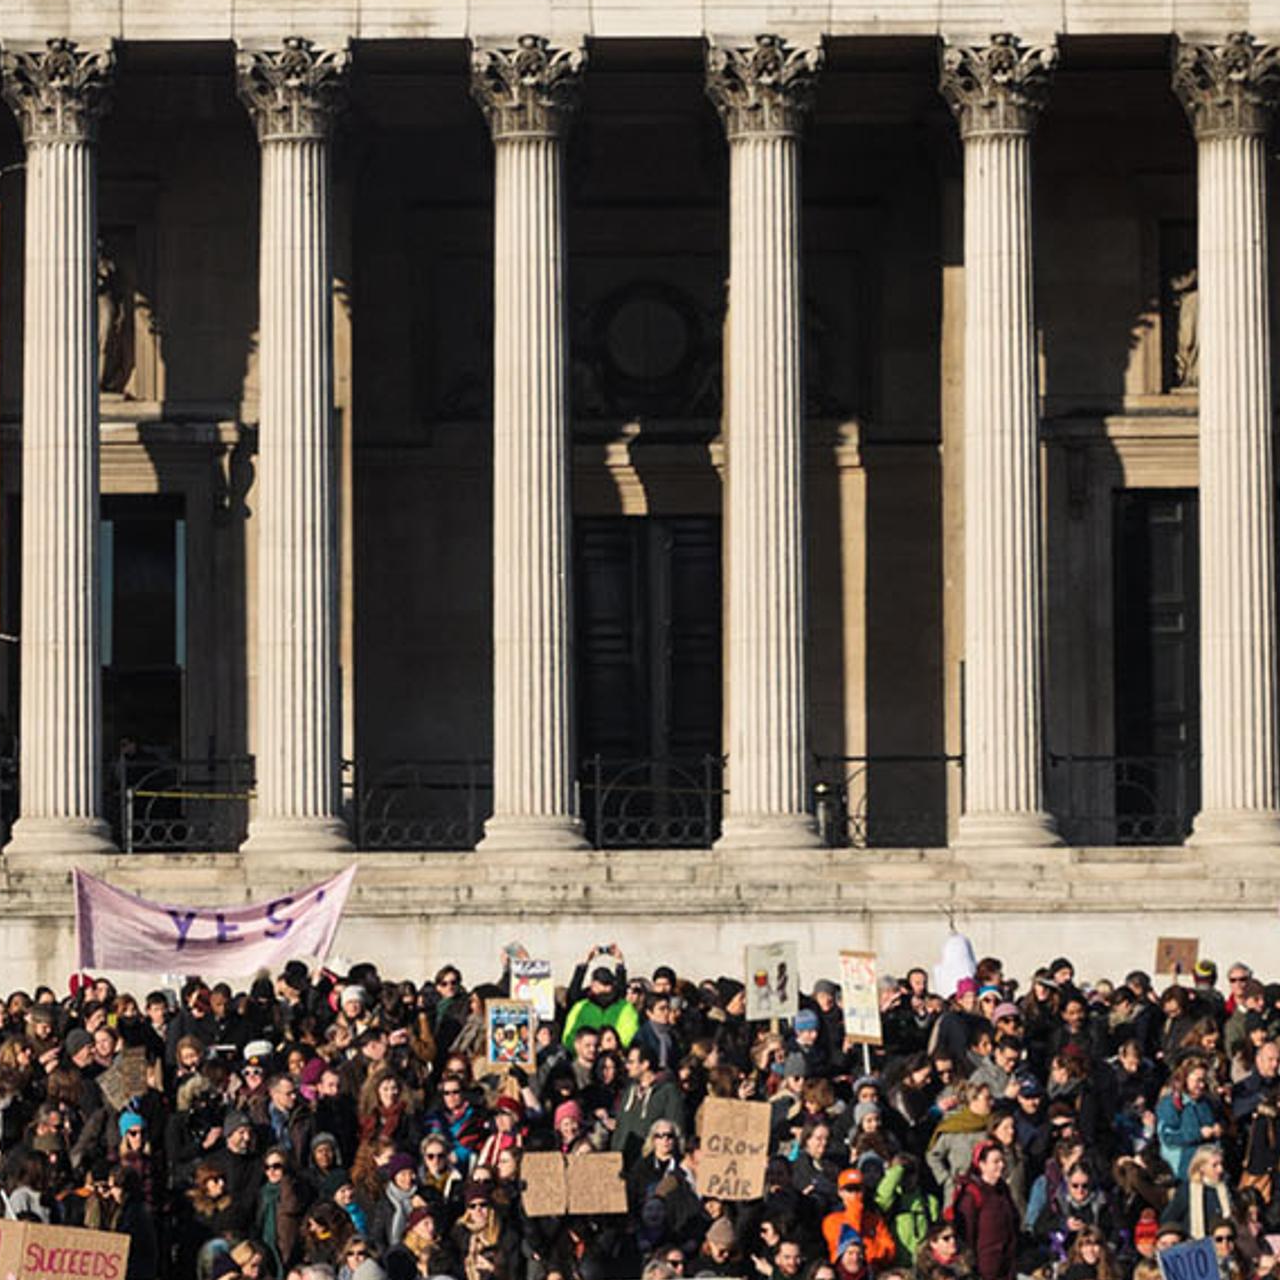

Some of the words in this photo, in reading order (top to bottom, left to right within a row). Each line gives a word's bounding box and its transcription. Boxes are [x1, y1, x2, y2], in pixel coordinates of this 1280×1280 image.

[706, 1134, 766, 1154] GROW
[723, 1159, 739, 1175] A
[707, 1176, 752, 1196] PAIR
